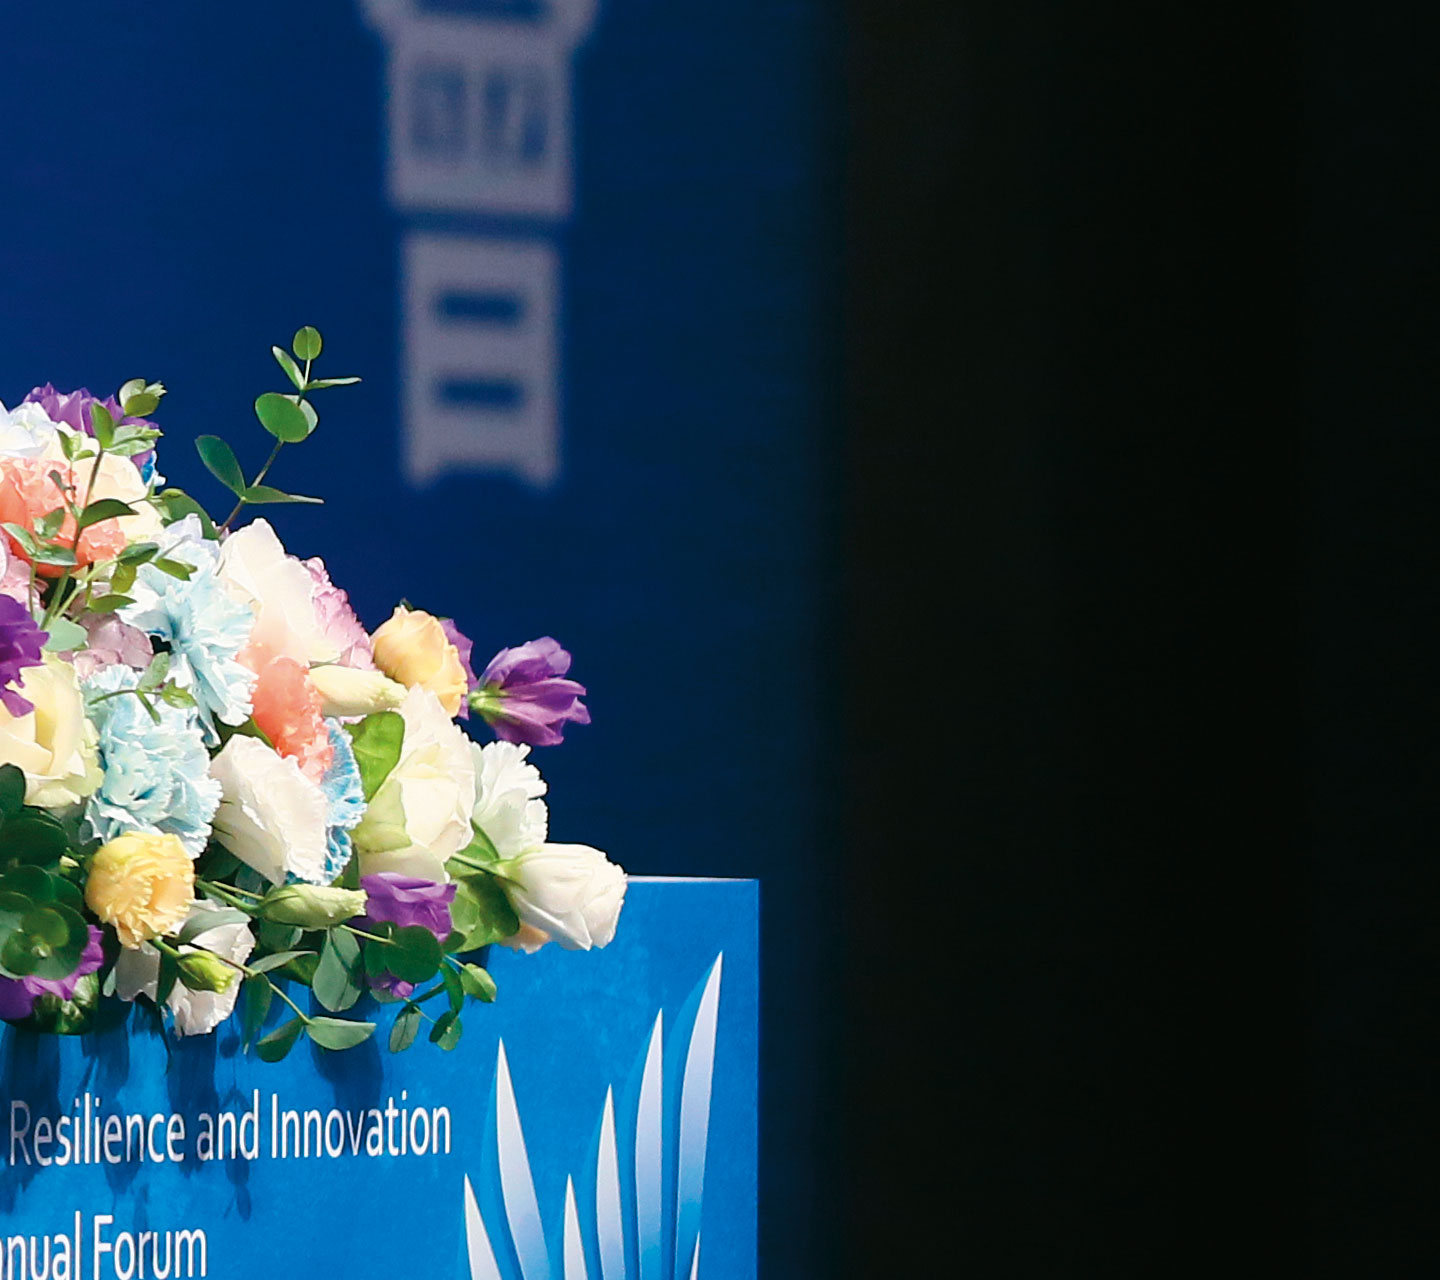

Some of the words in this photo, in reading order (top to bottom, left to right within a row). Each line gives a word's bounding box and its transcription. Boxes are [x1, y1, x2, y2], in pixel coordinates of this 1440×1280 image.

[9, 1090, 186, 1167] Resilience
[196, 1088, 260, 1162] and
[270, 1090, 452, 1159] Innovation
[94, 1213, 208, 1280] Forum
